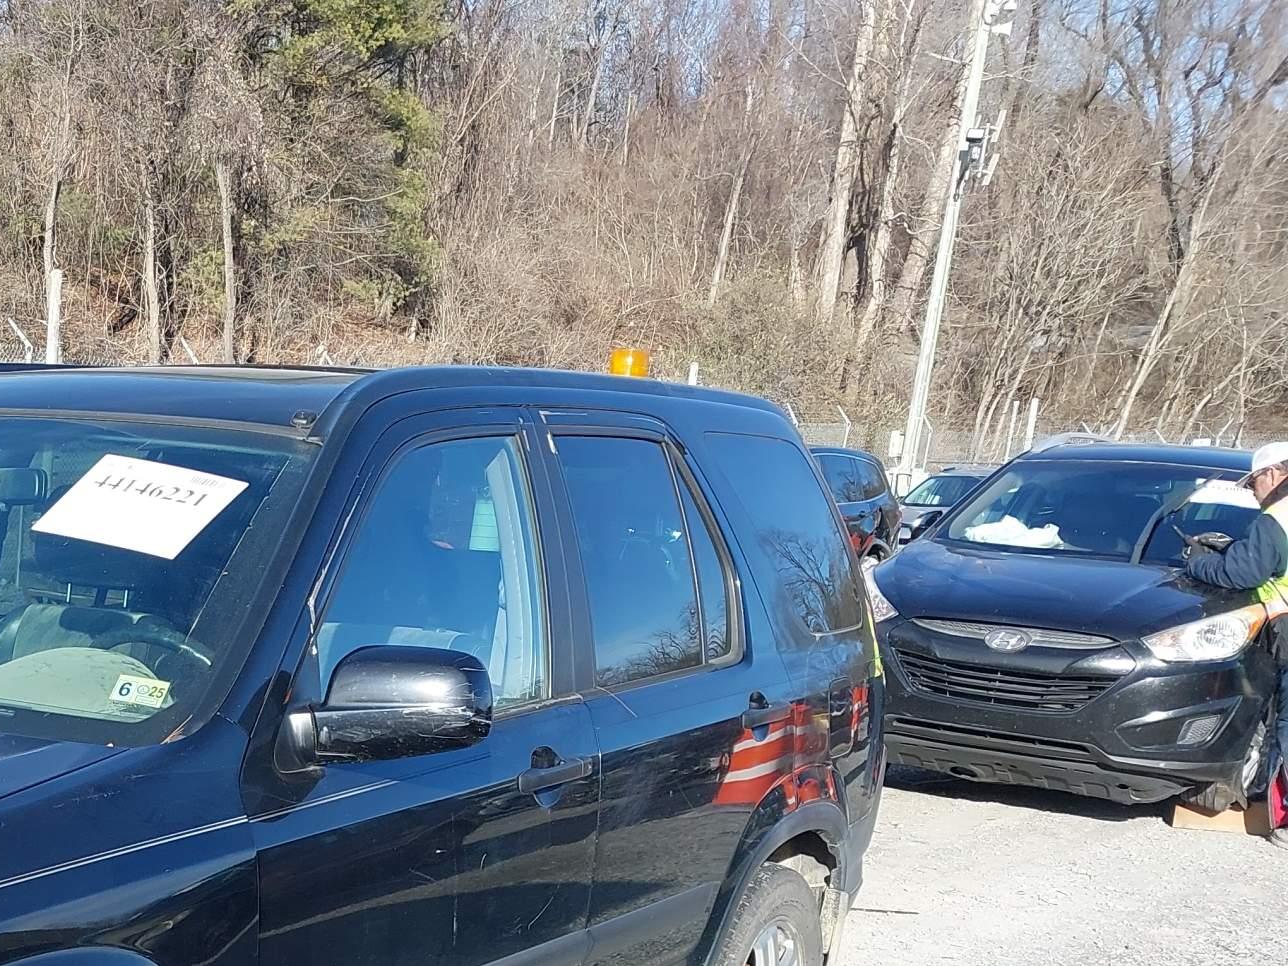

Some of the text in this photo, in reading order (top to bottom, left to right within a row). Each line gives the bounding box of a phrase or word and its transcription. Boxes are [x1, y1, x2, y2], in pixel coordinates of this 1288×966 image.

[94, 475, 208, 506] 44146221
[119, 682, 166, 699] 6 25
